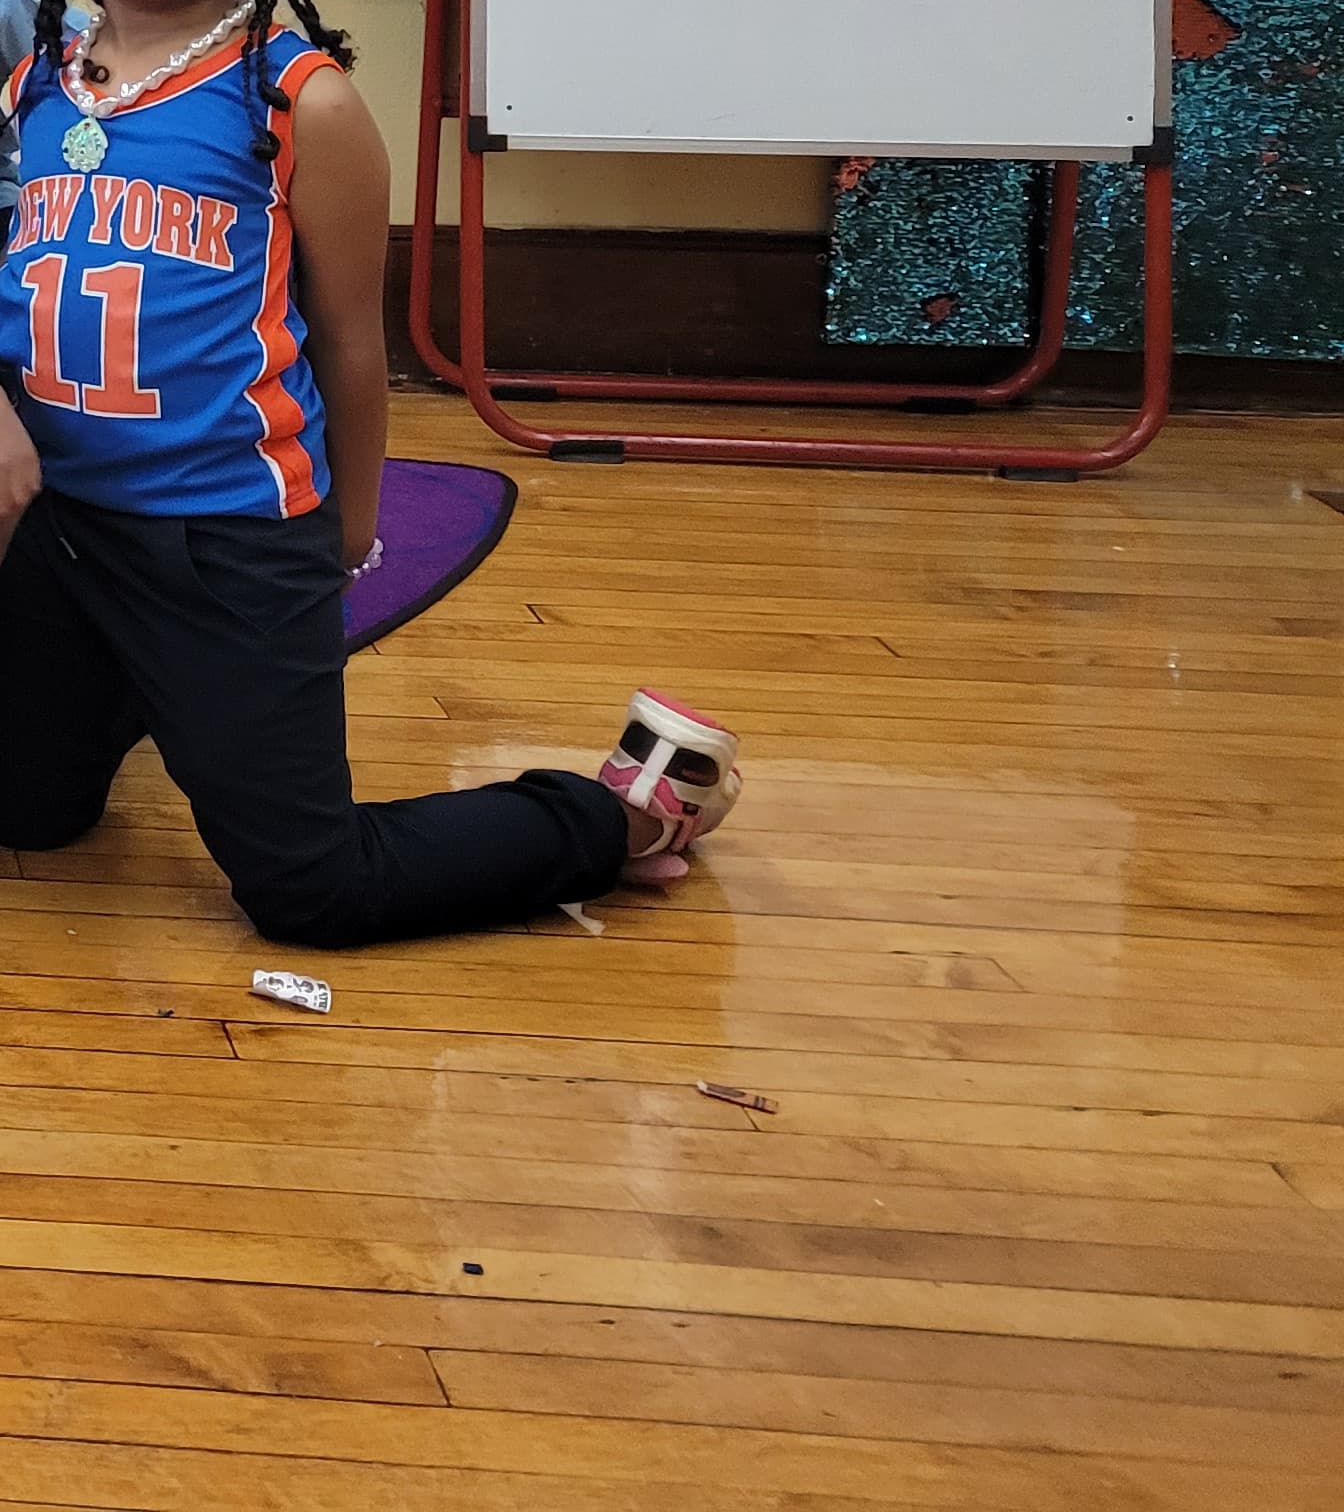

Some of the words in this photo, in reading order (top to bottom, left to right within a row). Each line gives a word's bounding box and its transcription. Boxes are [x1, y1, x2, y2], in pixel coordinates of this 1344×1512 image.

[8, 174, 85, 254] NEW
[89, 175, 237, 271] YORK
[22, 252, 161, 419] 11
